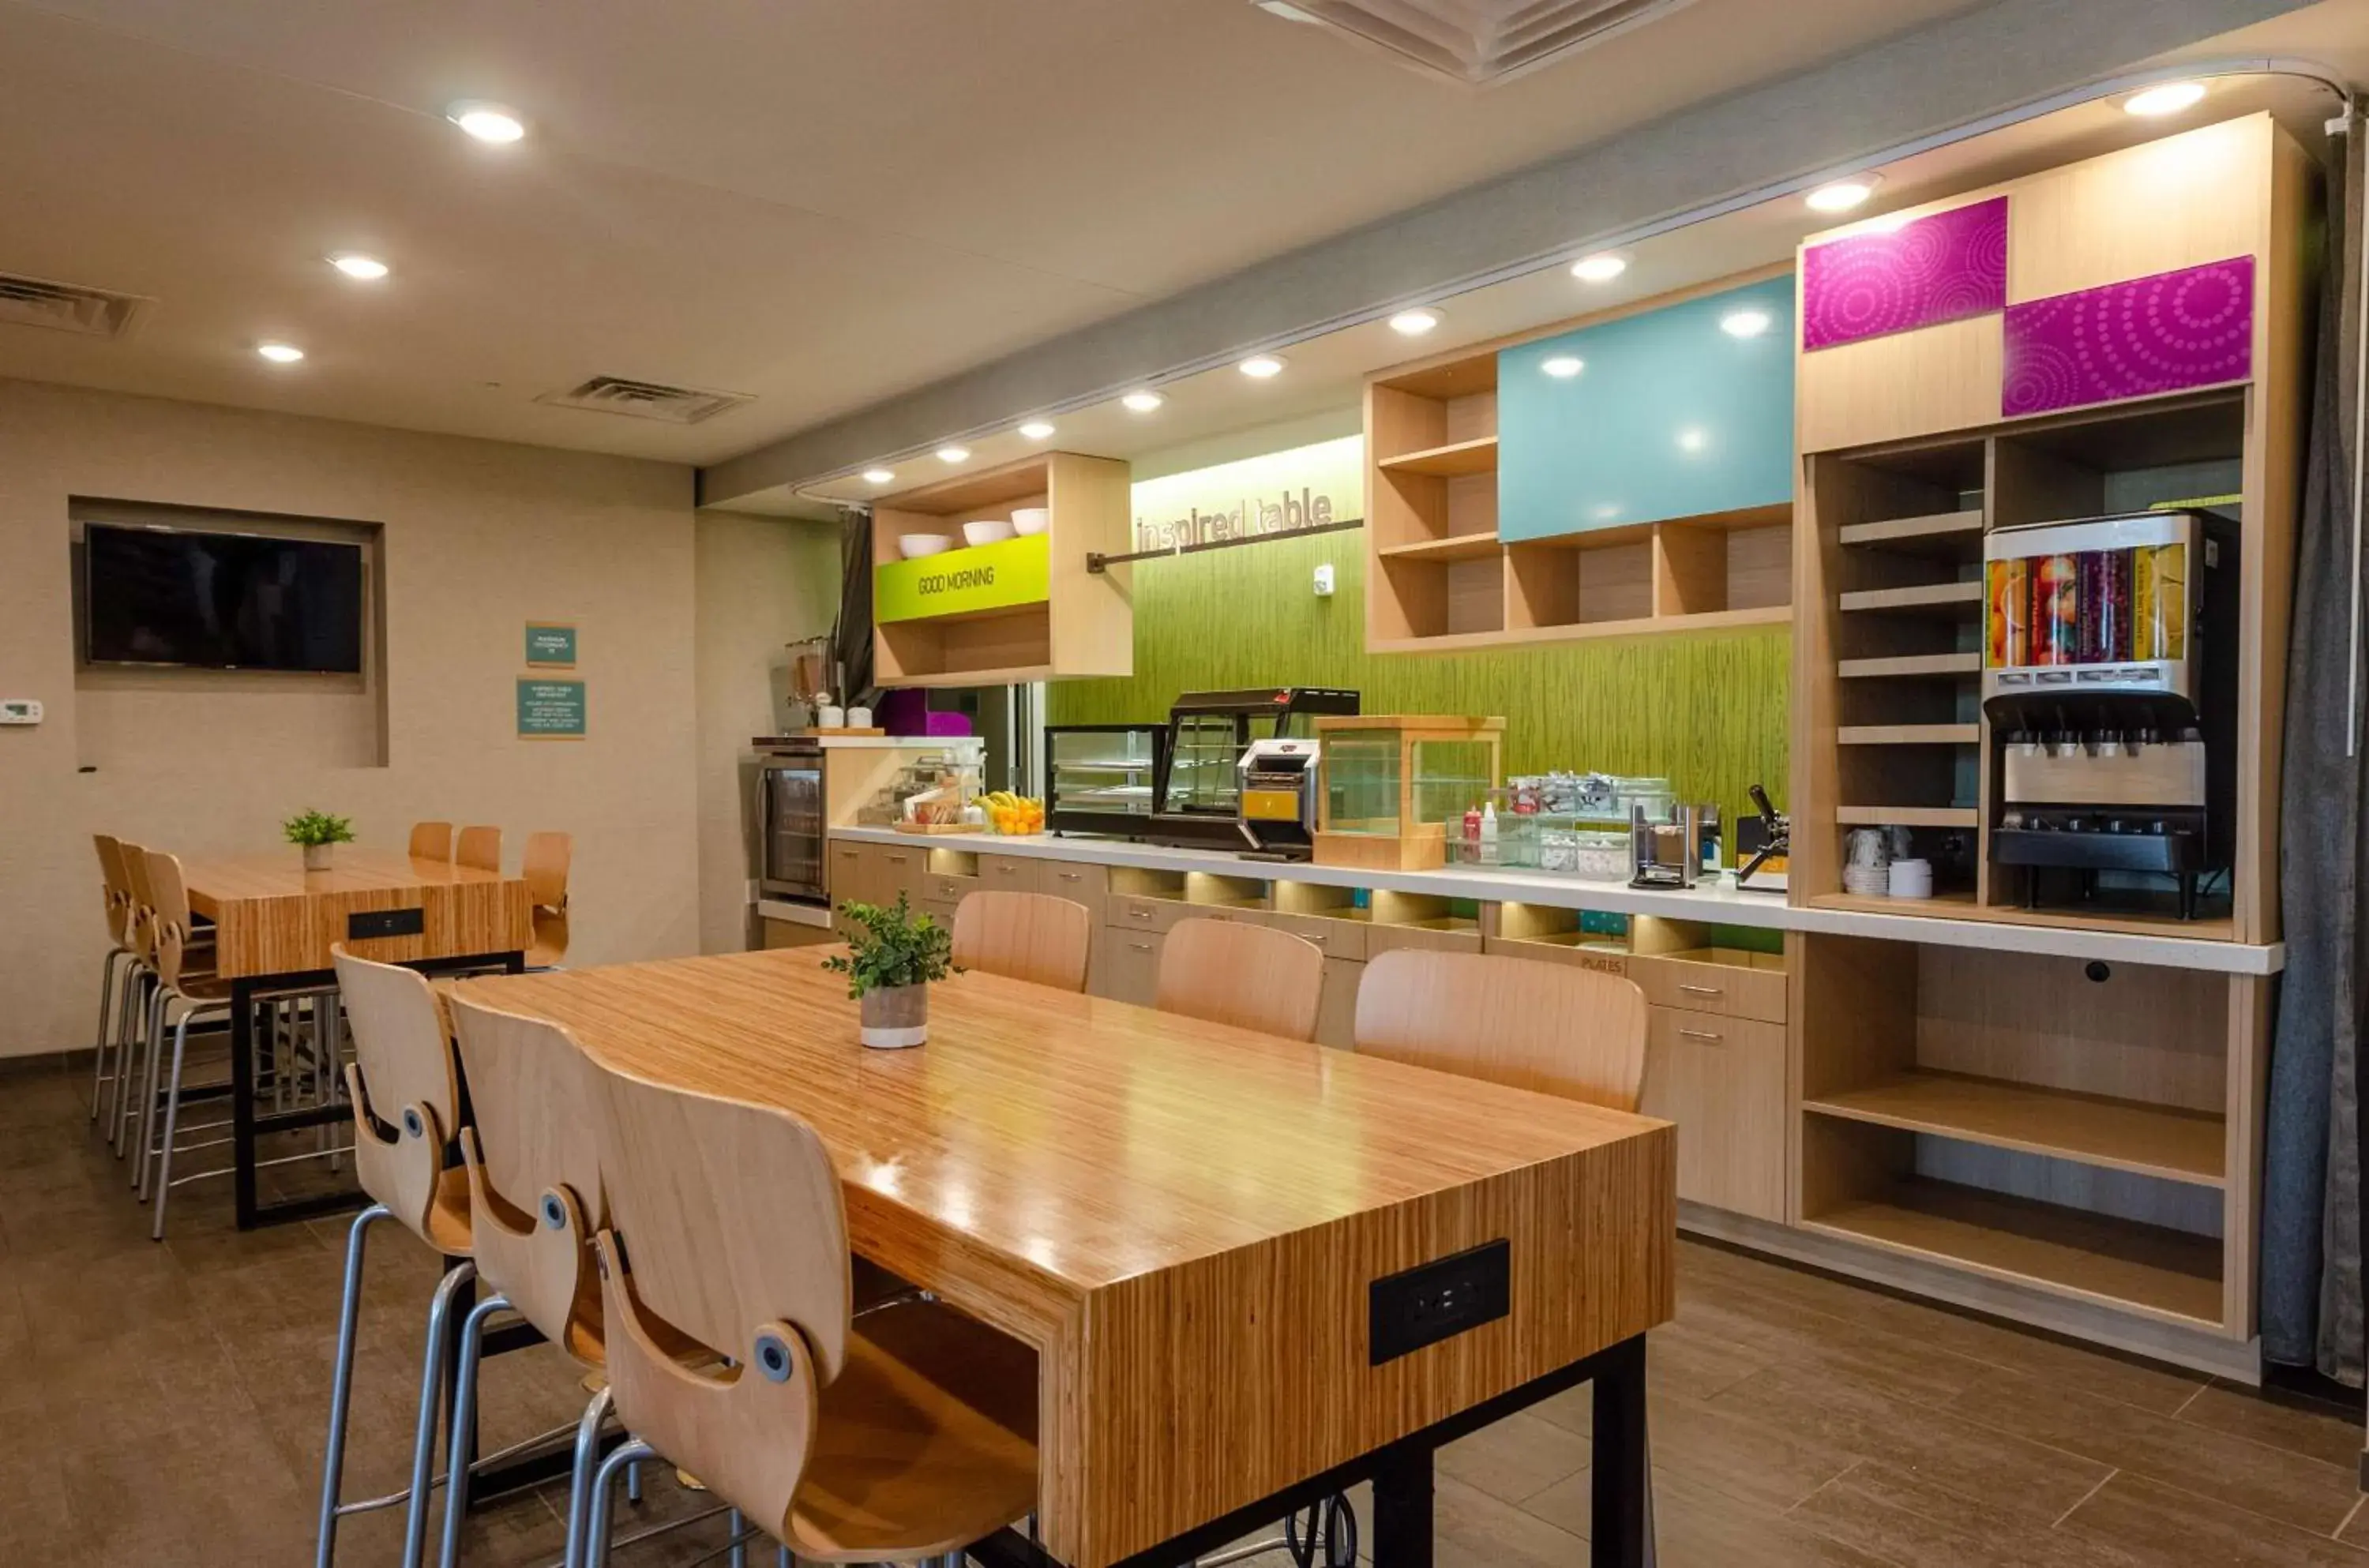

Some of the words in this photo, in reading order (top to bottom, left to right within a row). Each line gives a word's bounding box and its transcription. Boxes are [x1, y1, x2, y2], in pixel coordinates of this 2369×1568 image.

[1136, 501, 1246, 557] inspired
[1256, 487, 1332, 535] table
[918, 574, 945, 595] GOOD
[947, 565, 995, 591] MORNING
[1582, 956, 1622, 973] PLATES
